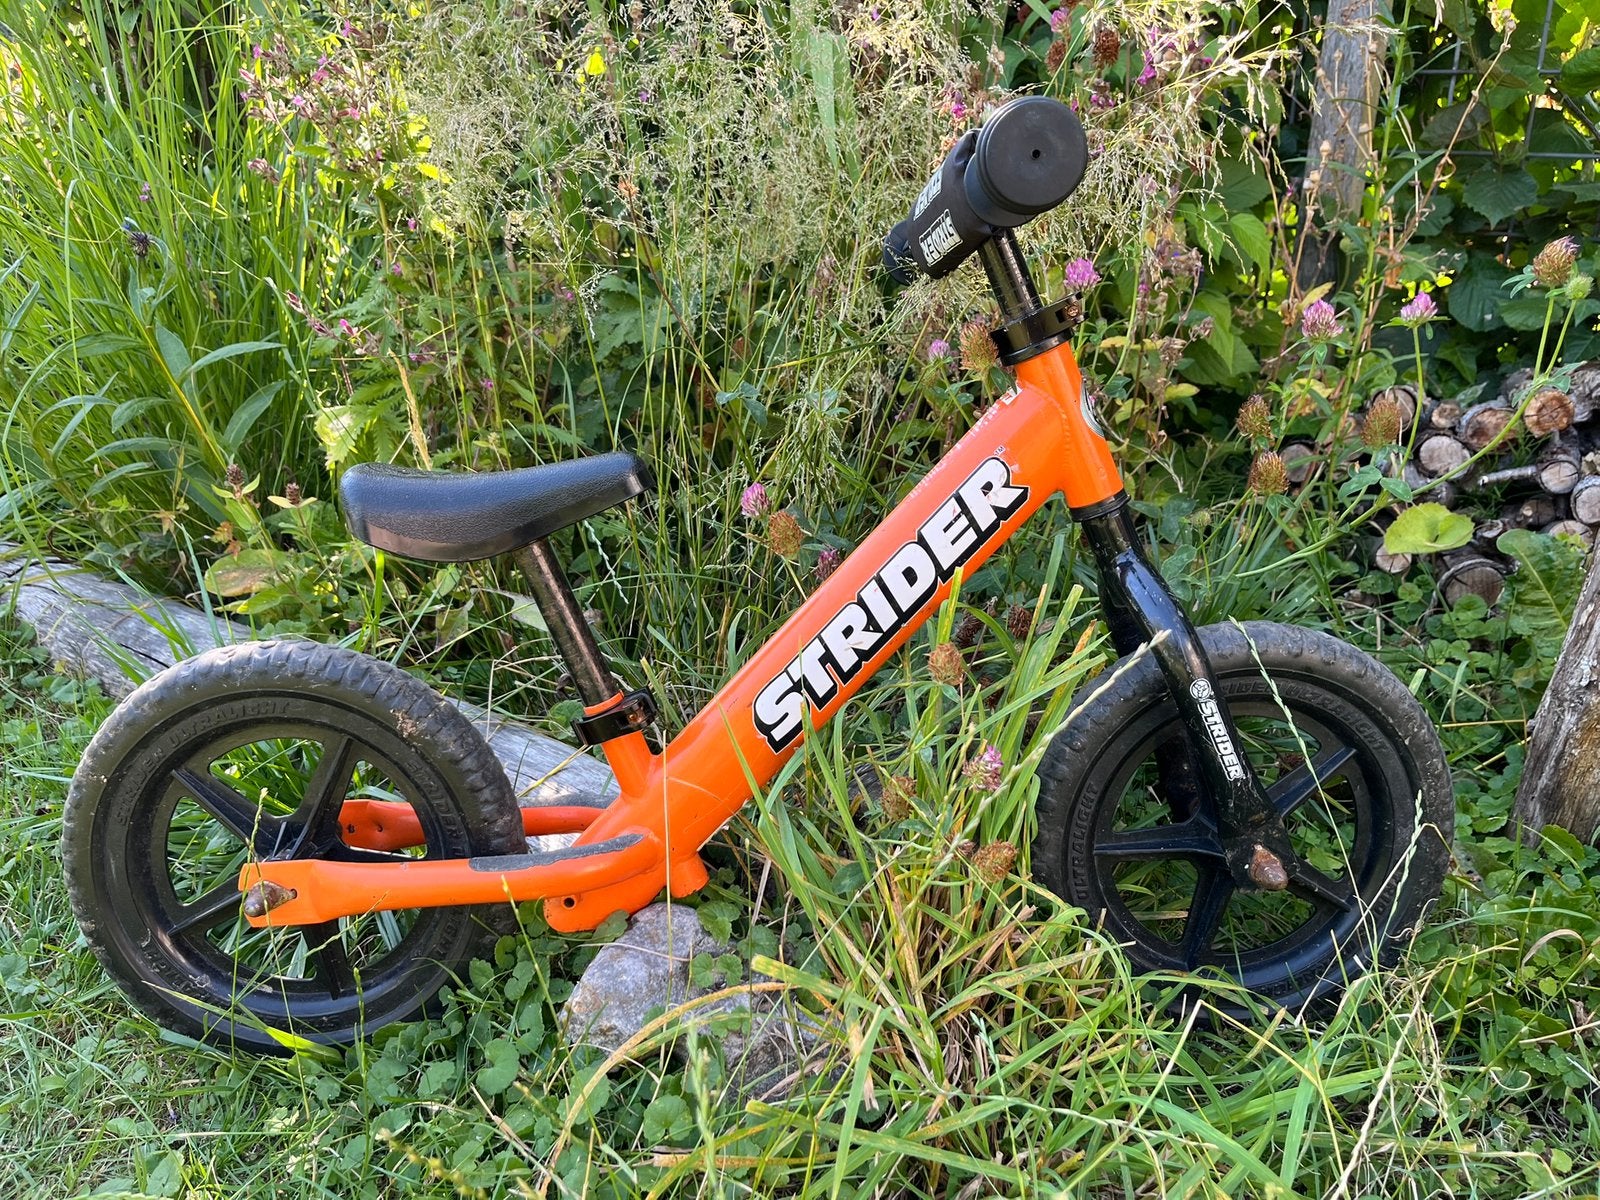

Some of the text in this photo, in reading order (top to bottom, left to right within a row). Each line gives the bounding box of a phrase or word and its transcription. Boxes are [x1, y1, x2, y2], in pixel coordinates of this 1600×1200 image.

[919, 212, 963, 267] STRIDER
[753, 456, 1029, 753] STRIDER
[168, 701, 291, 747] ULTRALIGHT
[1197, 699, 1245, 781] STRIDER
[1285, 684, 1388, 753] ULTRALIGHT
[404, 760, 463, 841] STRIDER
[1072, 782, 1098, 900] ULTRALIGHT
